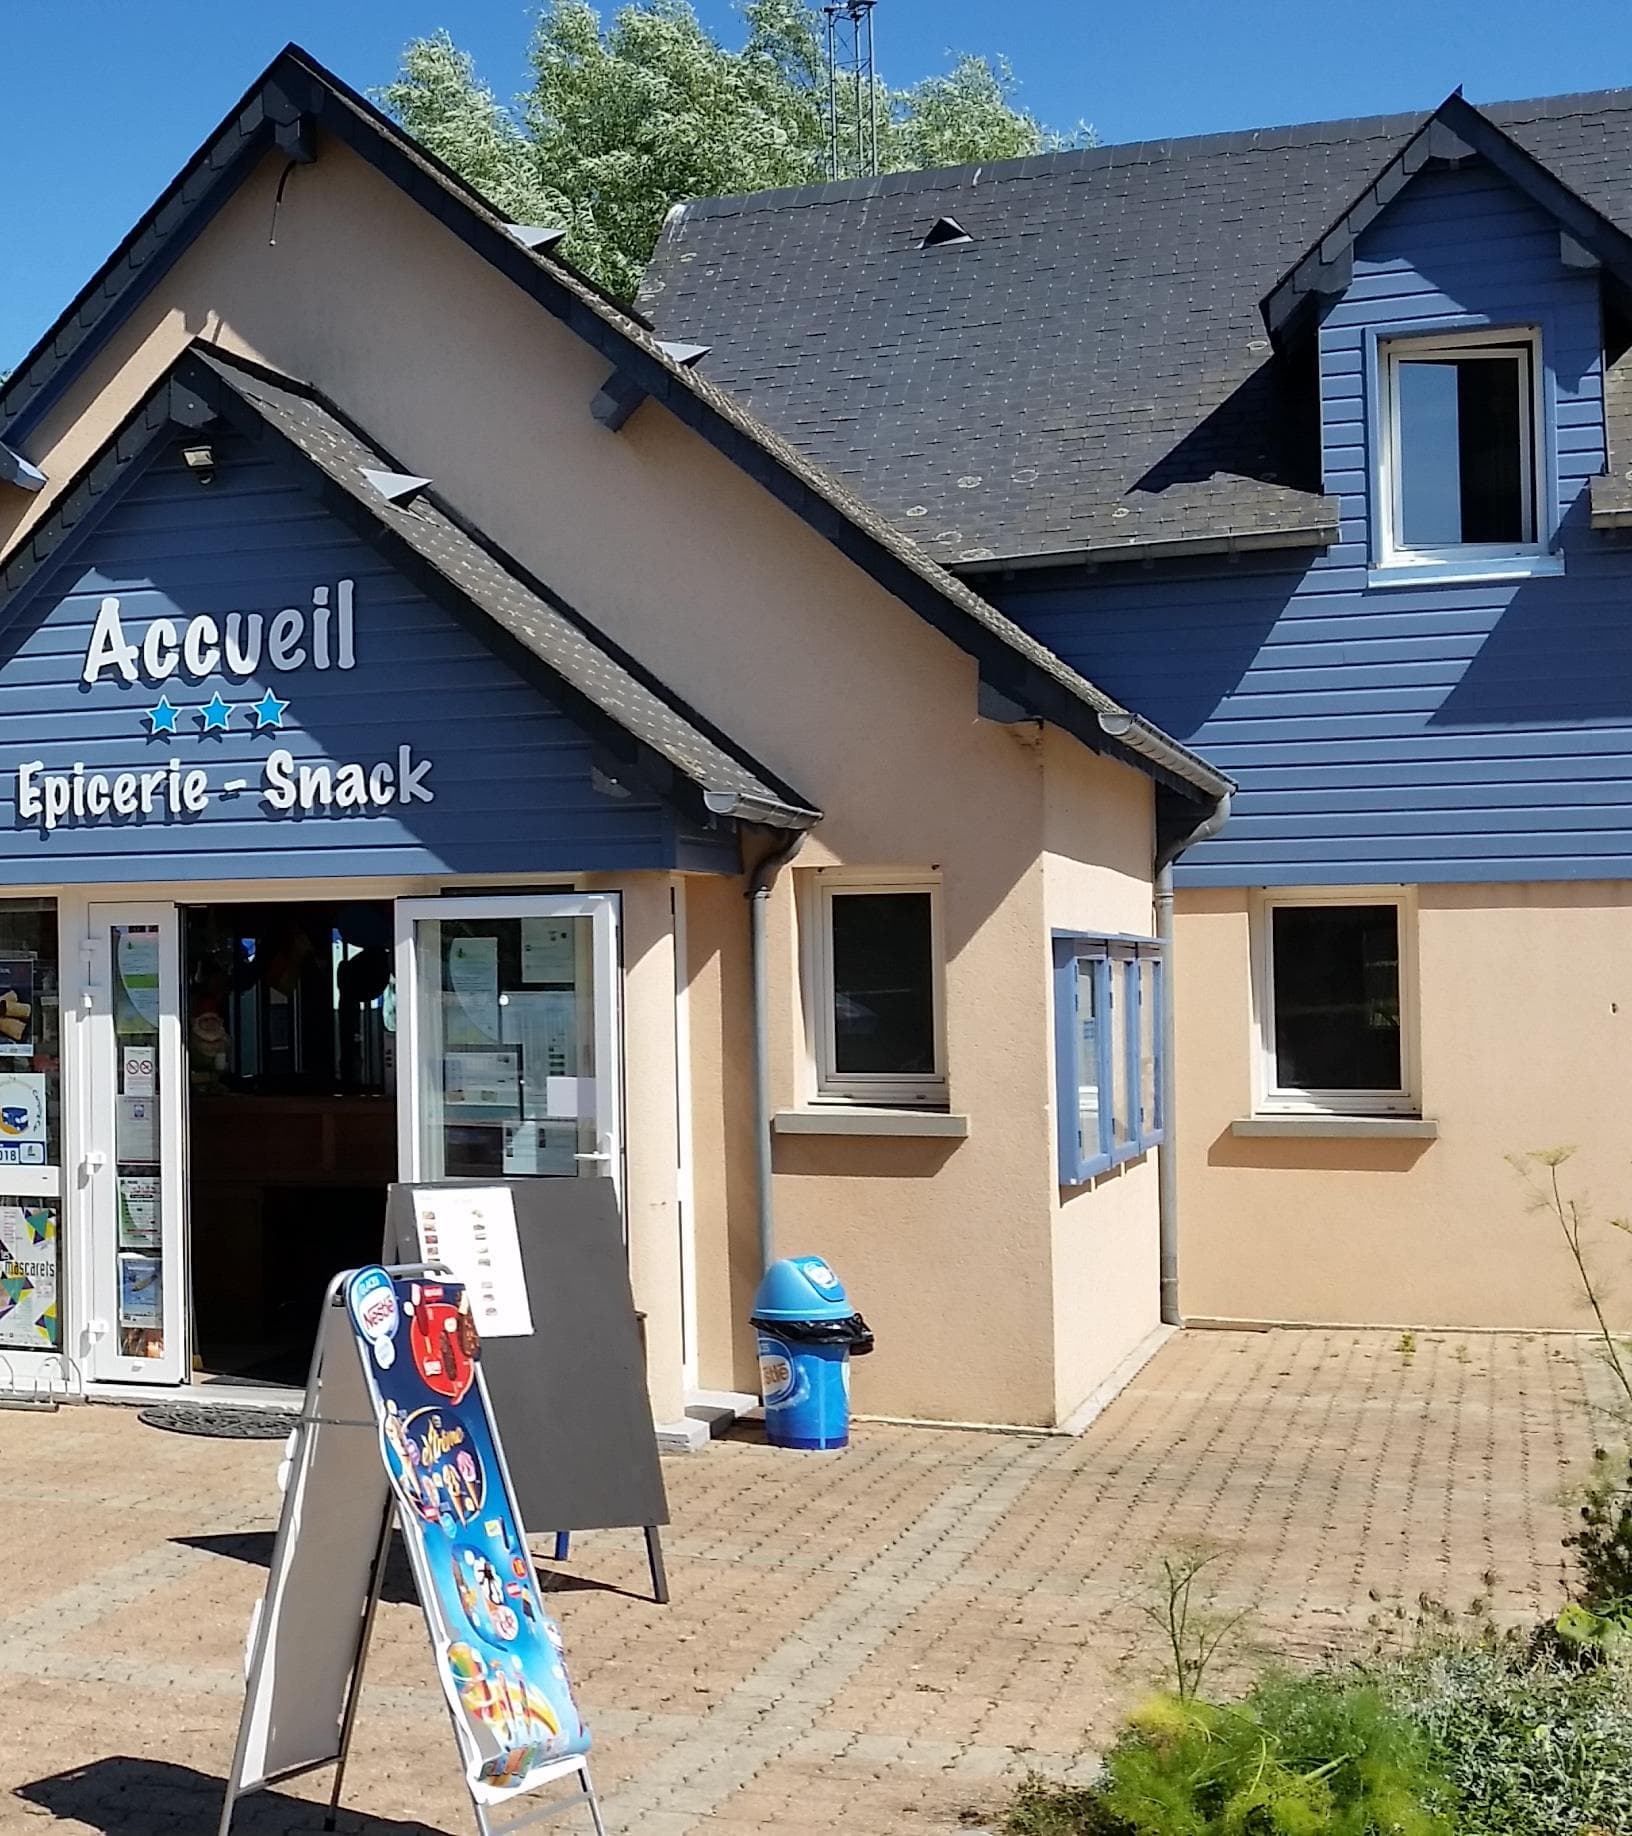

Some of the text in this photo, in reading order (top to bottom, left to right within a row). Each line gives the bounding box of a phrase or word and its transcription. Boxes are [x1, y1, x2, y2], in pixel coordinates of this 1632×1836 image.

[82, 578, 357, 684] Accueil
[18, 757, 209, 830] Epicerie
[264, 743, 435, 810] Snack
[4, 1260, 55, 1277] mascarets
